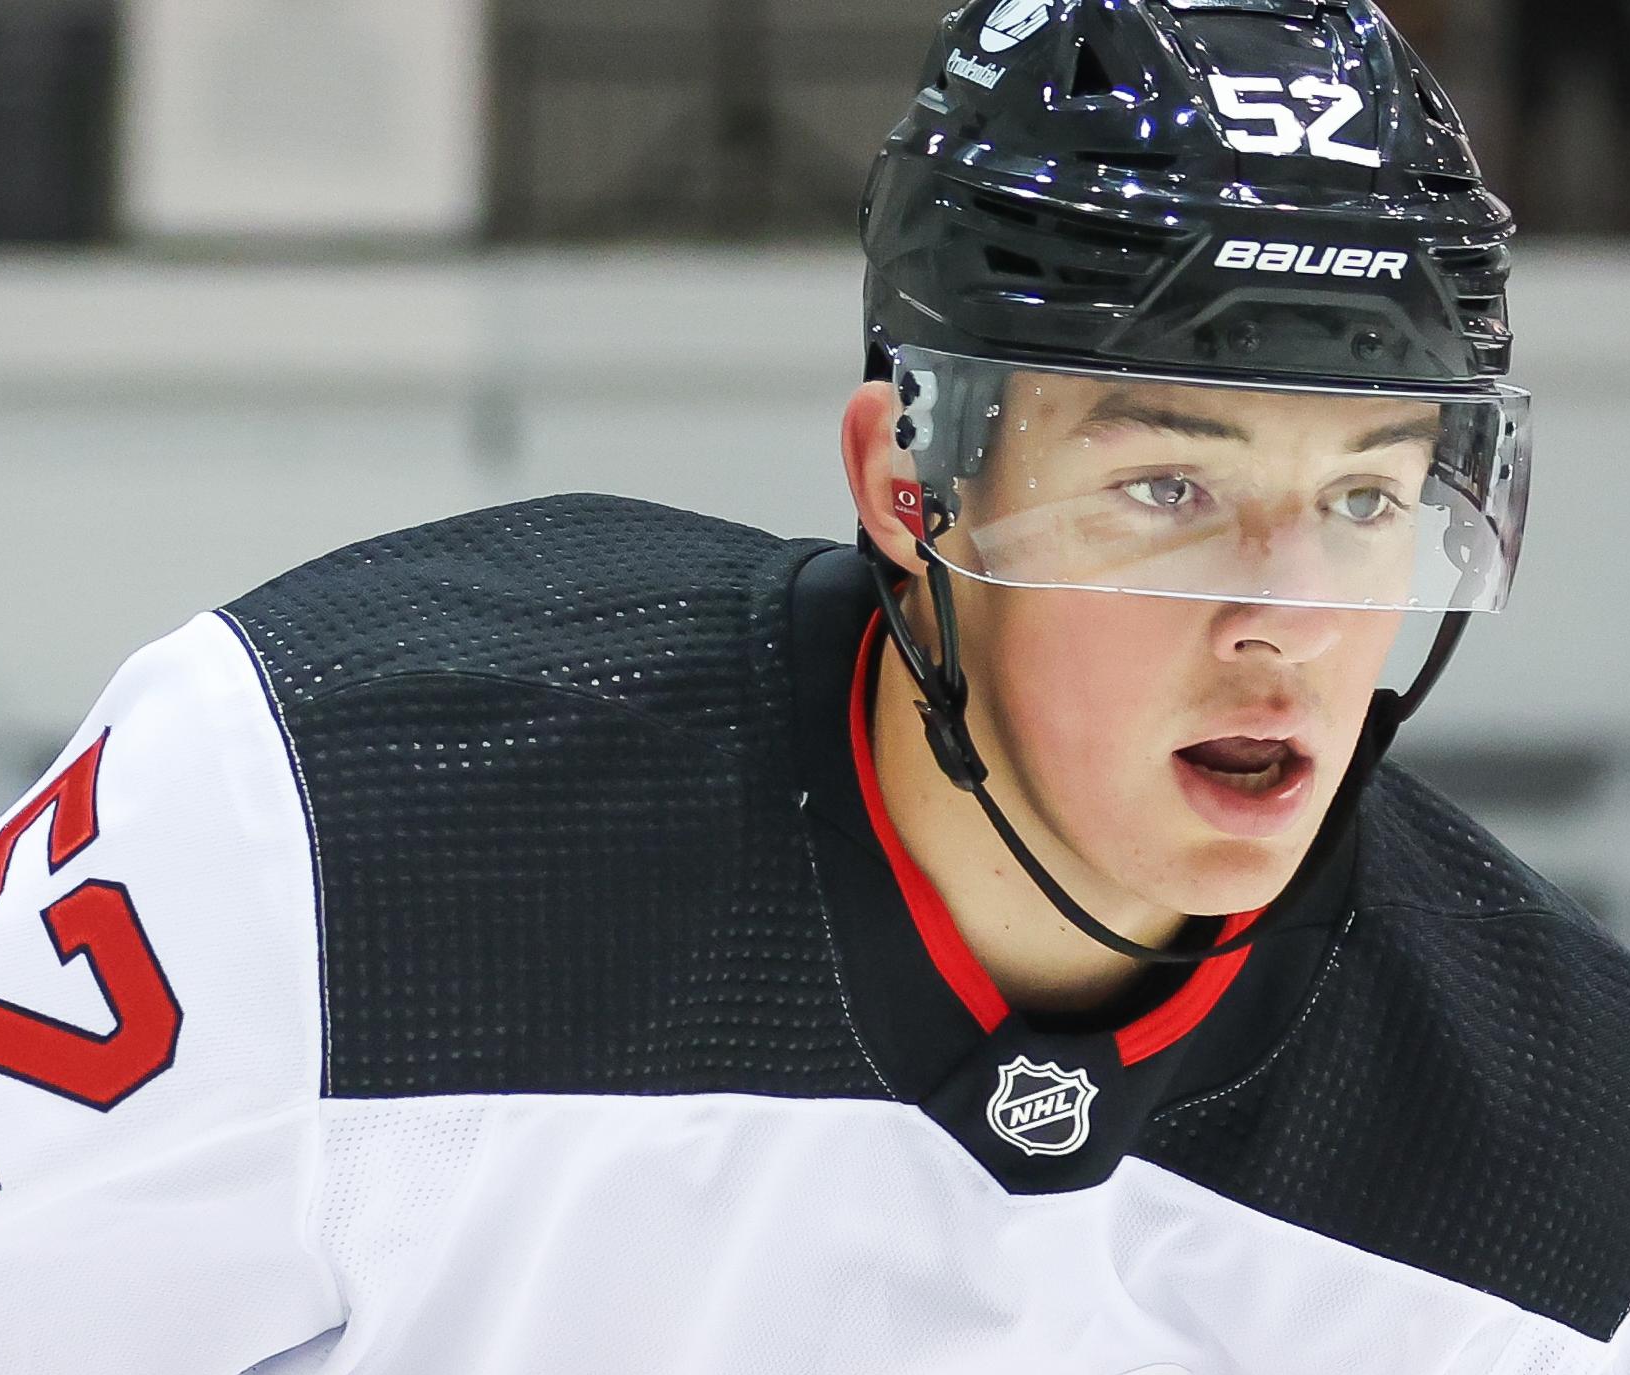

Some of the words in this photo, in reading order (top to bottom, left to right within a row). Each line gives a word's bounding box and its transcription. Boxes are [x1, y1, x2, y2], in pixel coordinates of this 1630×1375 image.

[1207, 73, 1381, 168] 52
[1214, 240, 1408, 280] BAUER
[1009, 1090, 1073, 1127] NHL
